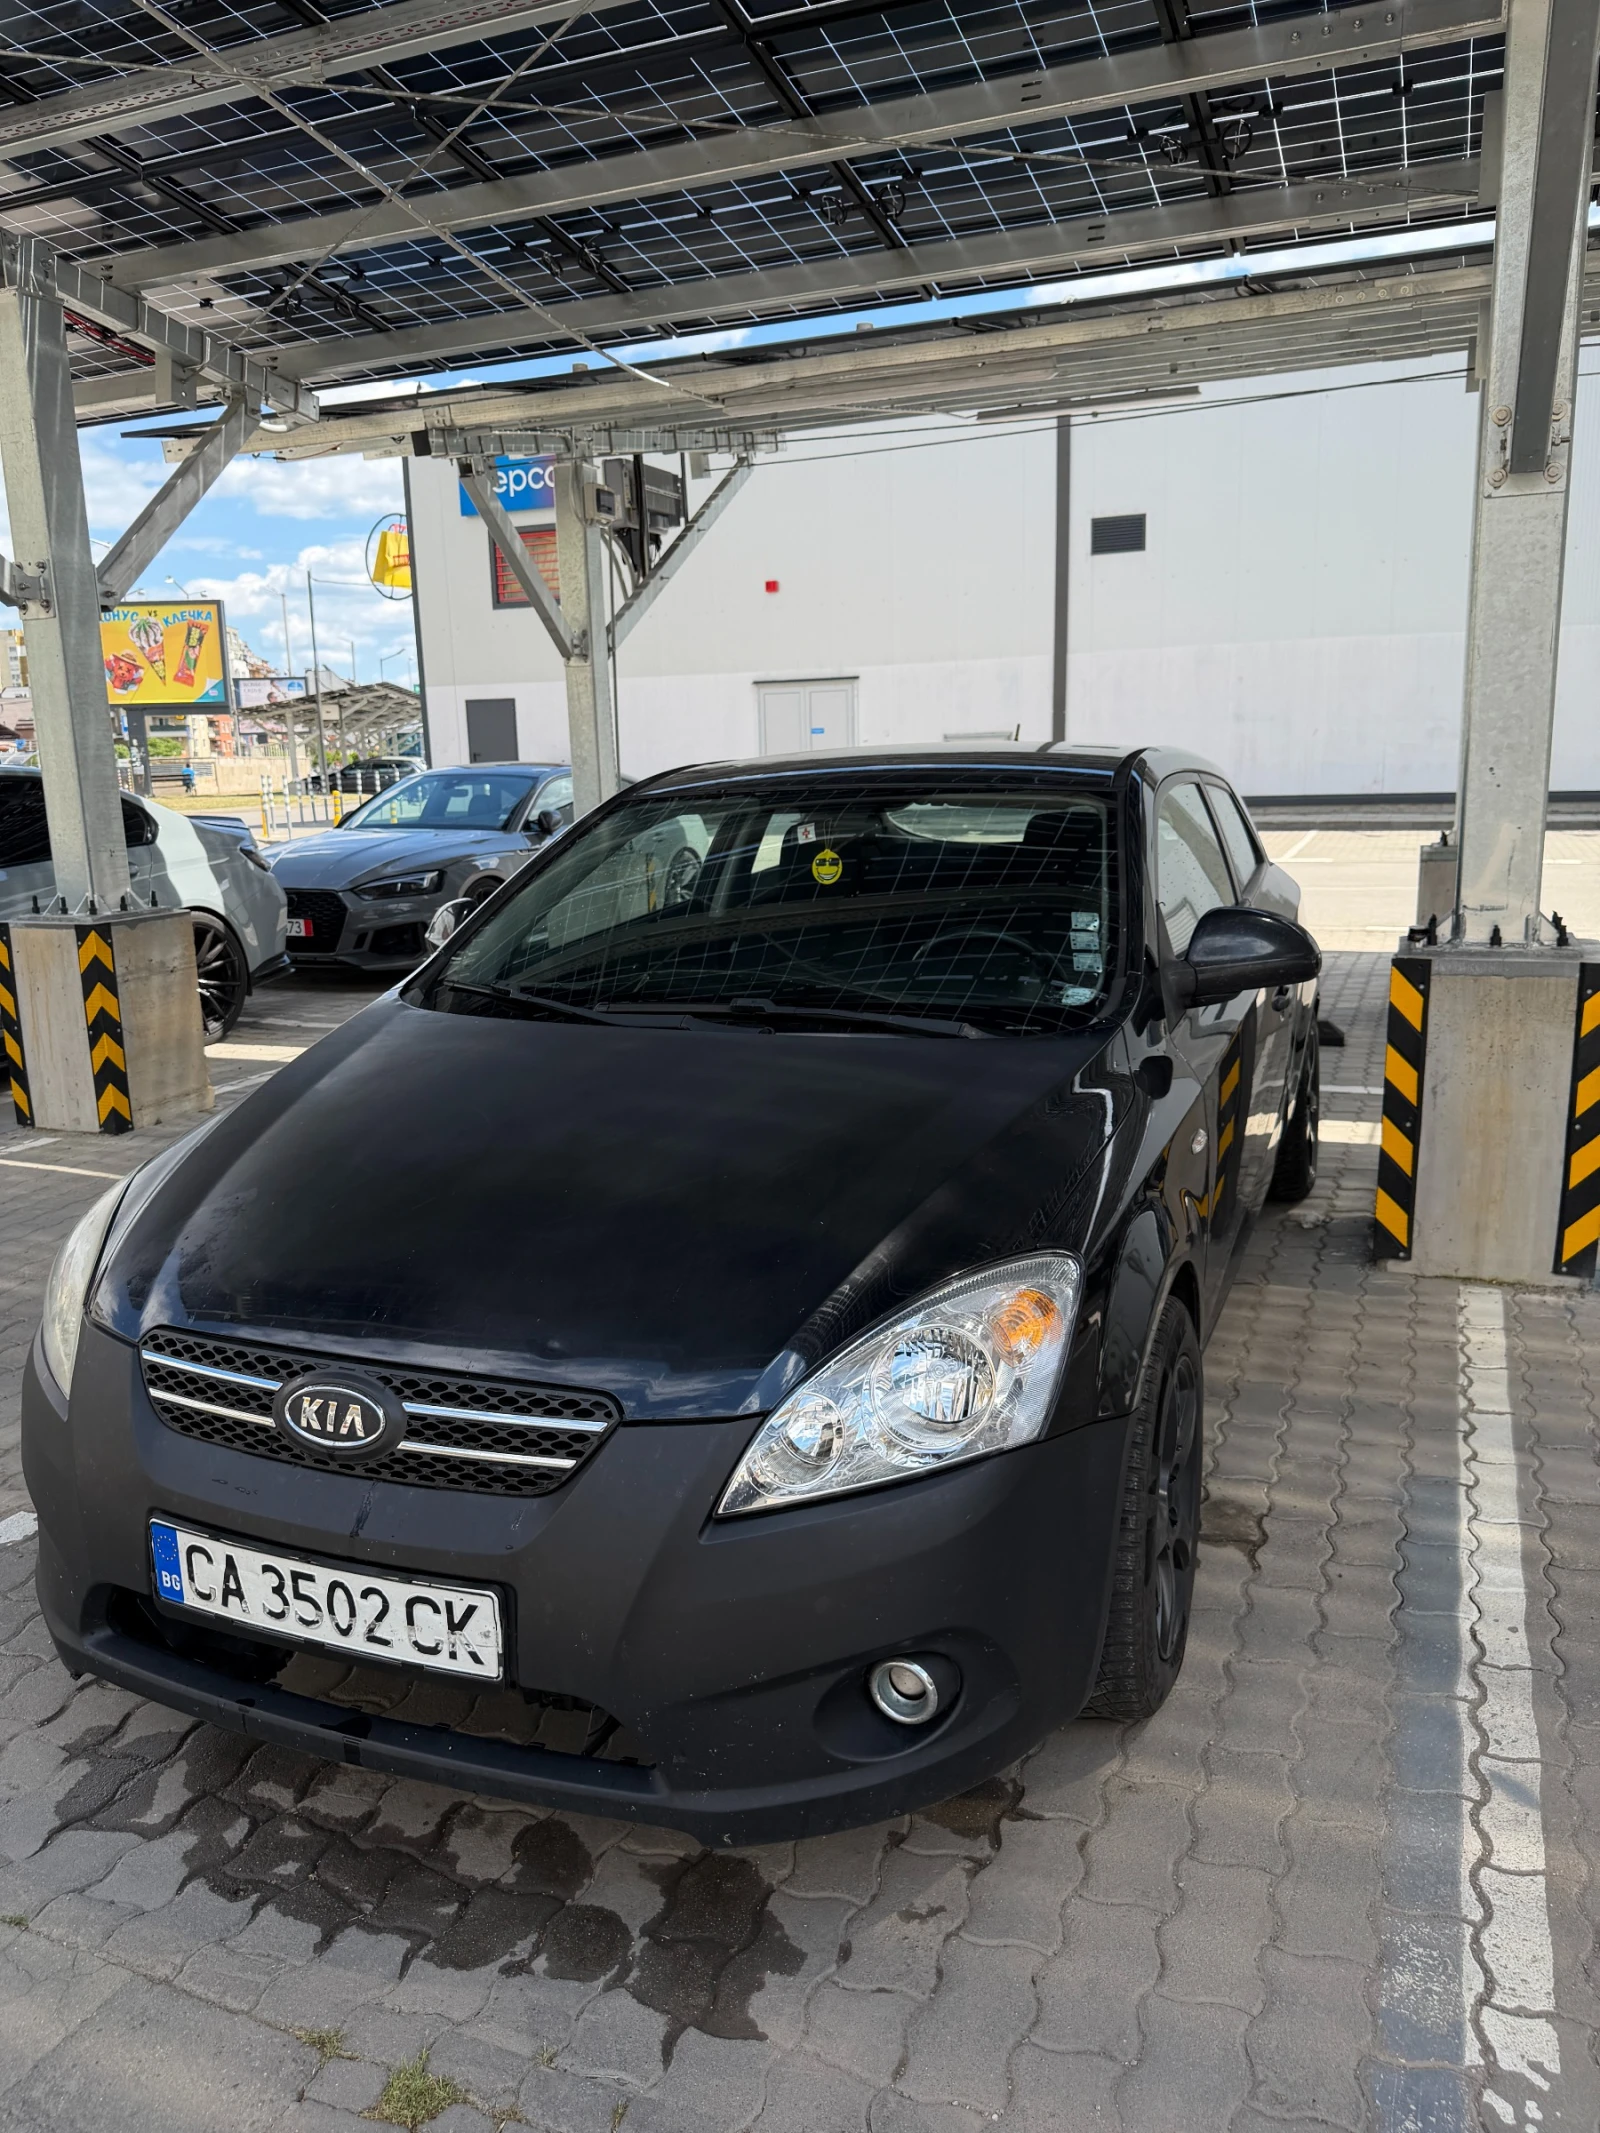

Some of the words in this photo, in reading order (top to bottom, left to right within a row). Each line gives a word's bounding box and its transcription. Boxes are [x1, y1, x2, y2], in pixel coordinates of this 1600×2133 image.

[100, 609, 139, 623] ОНУС
[162, 609, 213, 628] КЛЕЧКА
[286, 920, 302, 934] 73
[300, 1396, 365, 1437] KIA
[161, 1570, 181, 1591] BG
[262, 1564, 394, 1648] 3502
